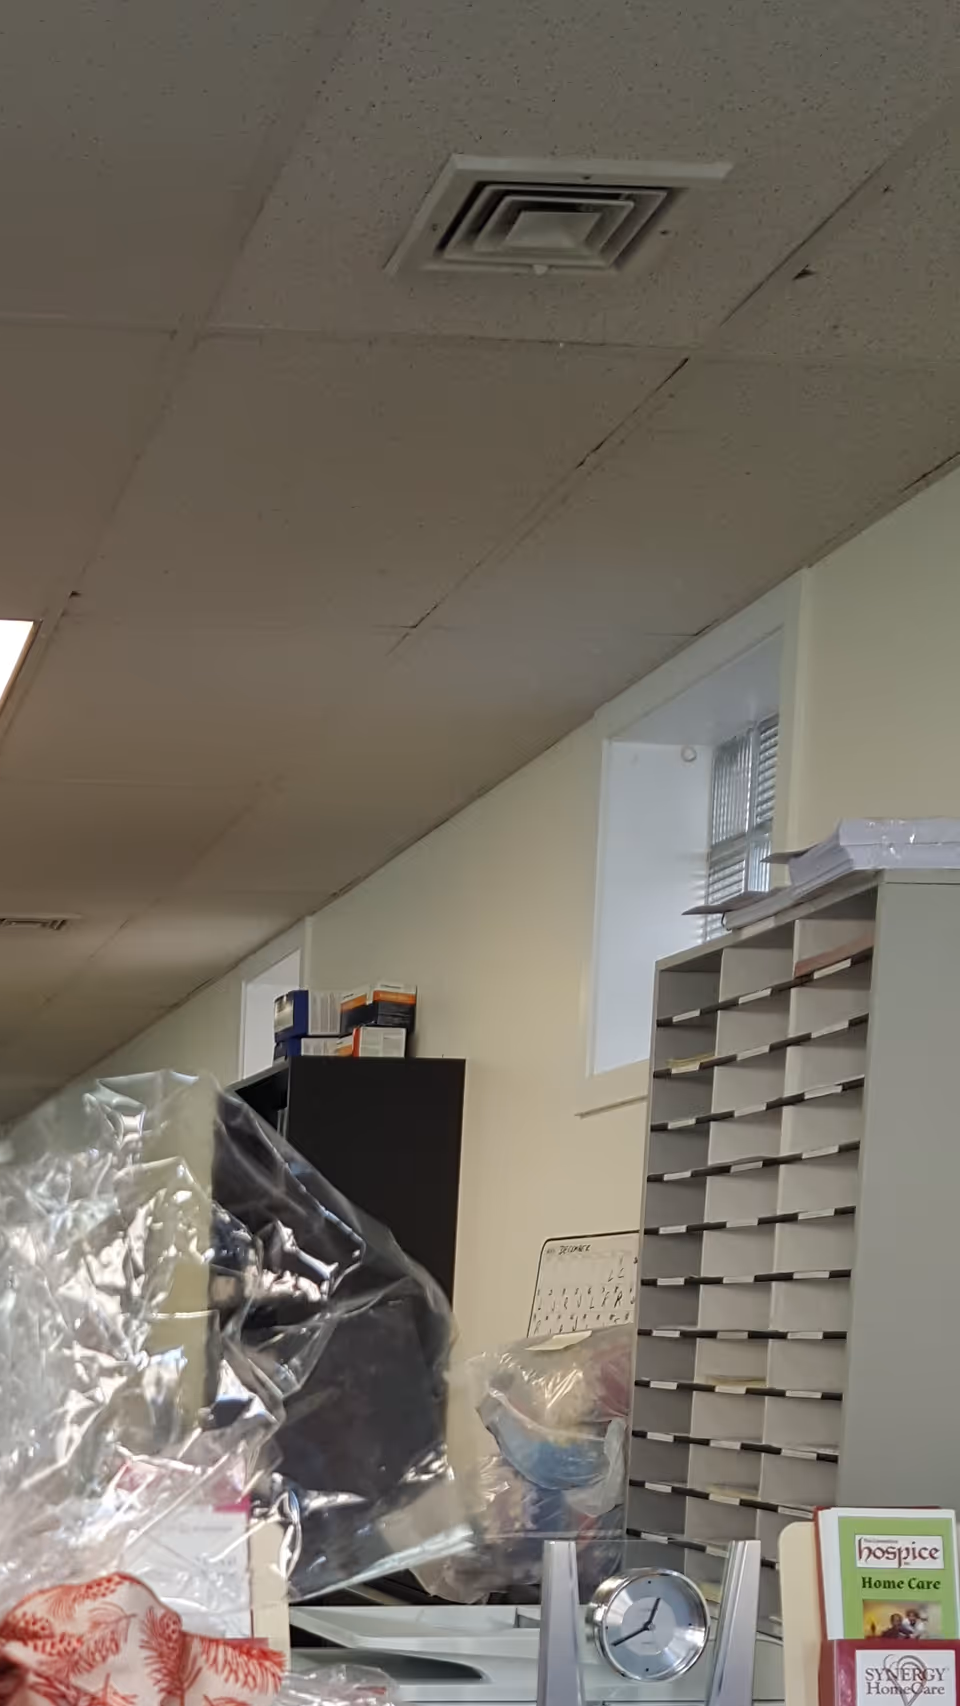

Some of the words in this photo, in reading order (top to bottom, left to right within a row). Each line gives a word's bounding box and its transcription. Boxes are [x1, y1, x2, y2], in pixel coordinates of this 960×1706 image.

[857, 1536, 940, 1568] hospice
[861, 1576, 904, 1589] Home
[907, 1577, 941, 1590] Care
[865, 1668, 946, 1682] SYNERGY
[866, 1682, 945, 1695] HomeCare
